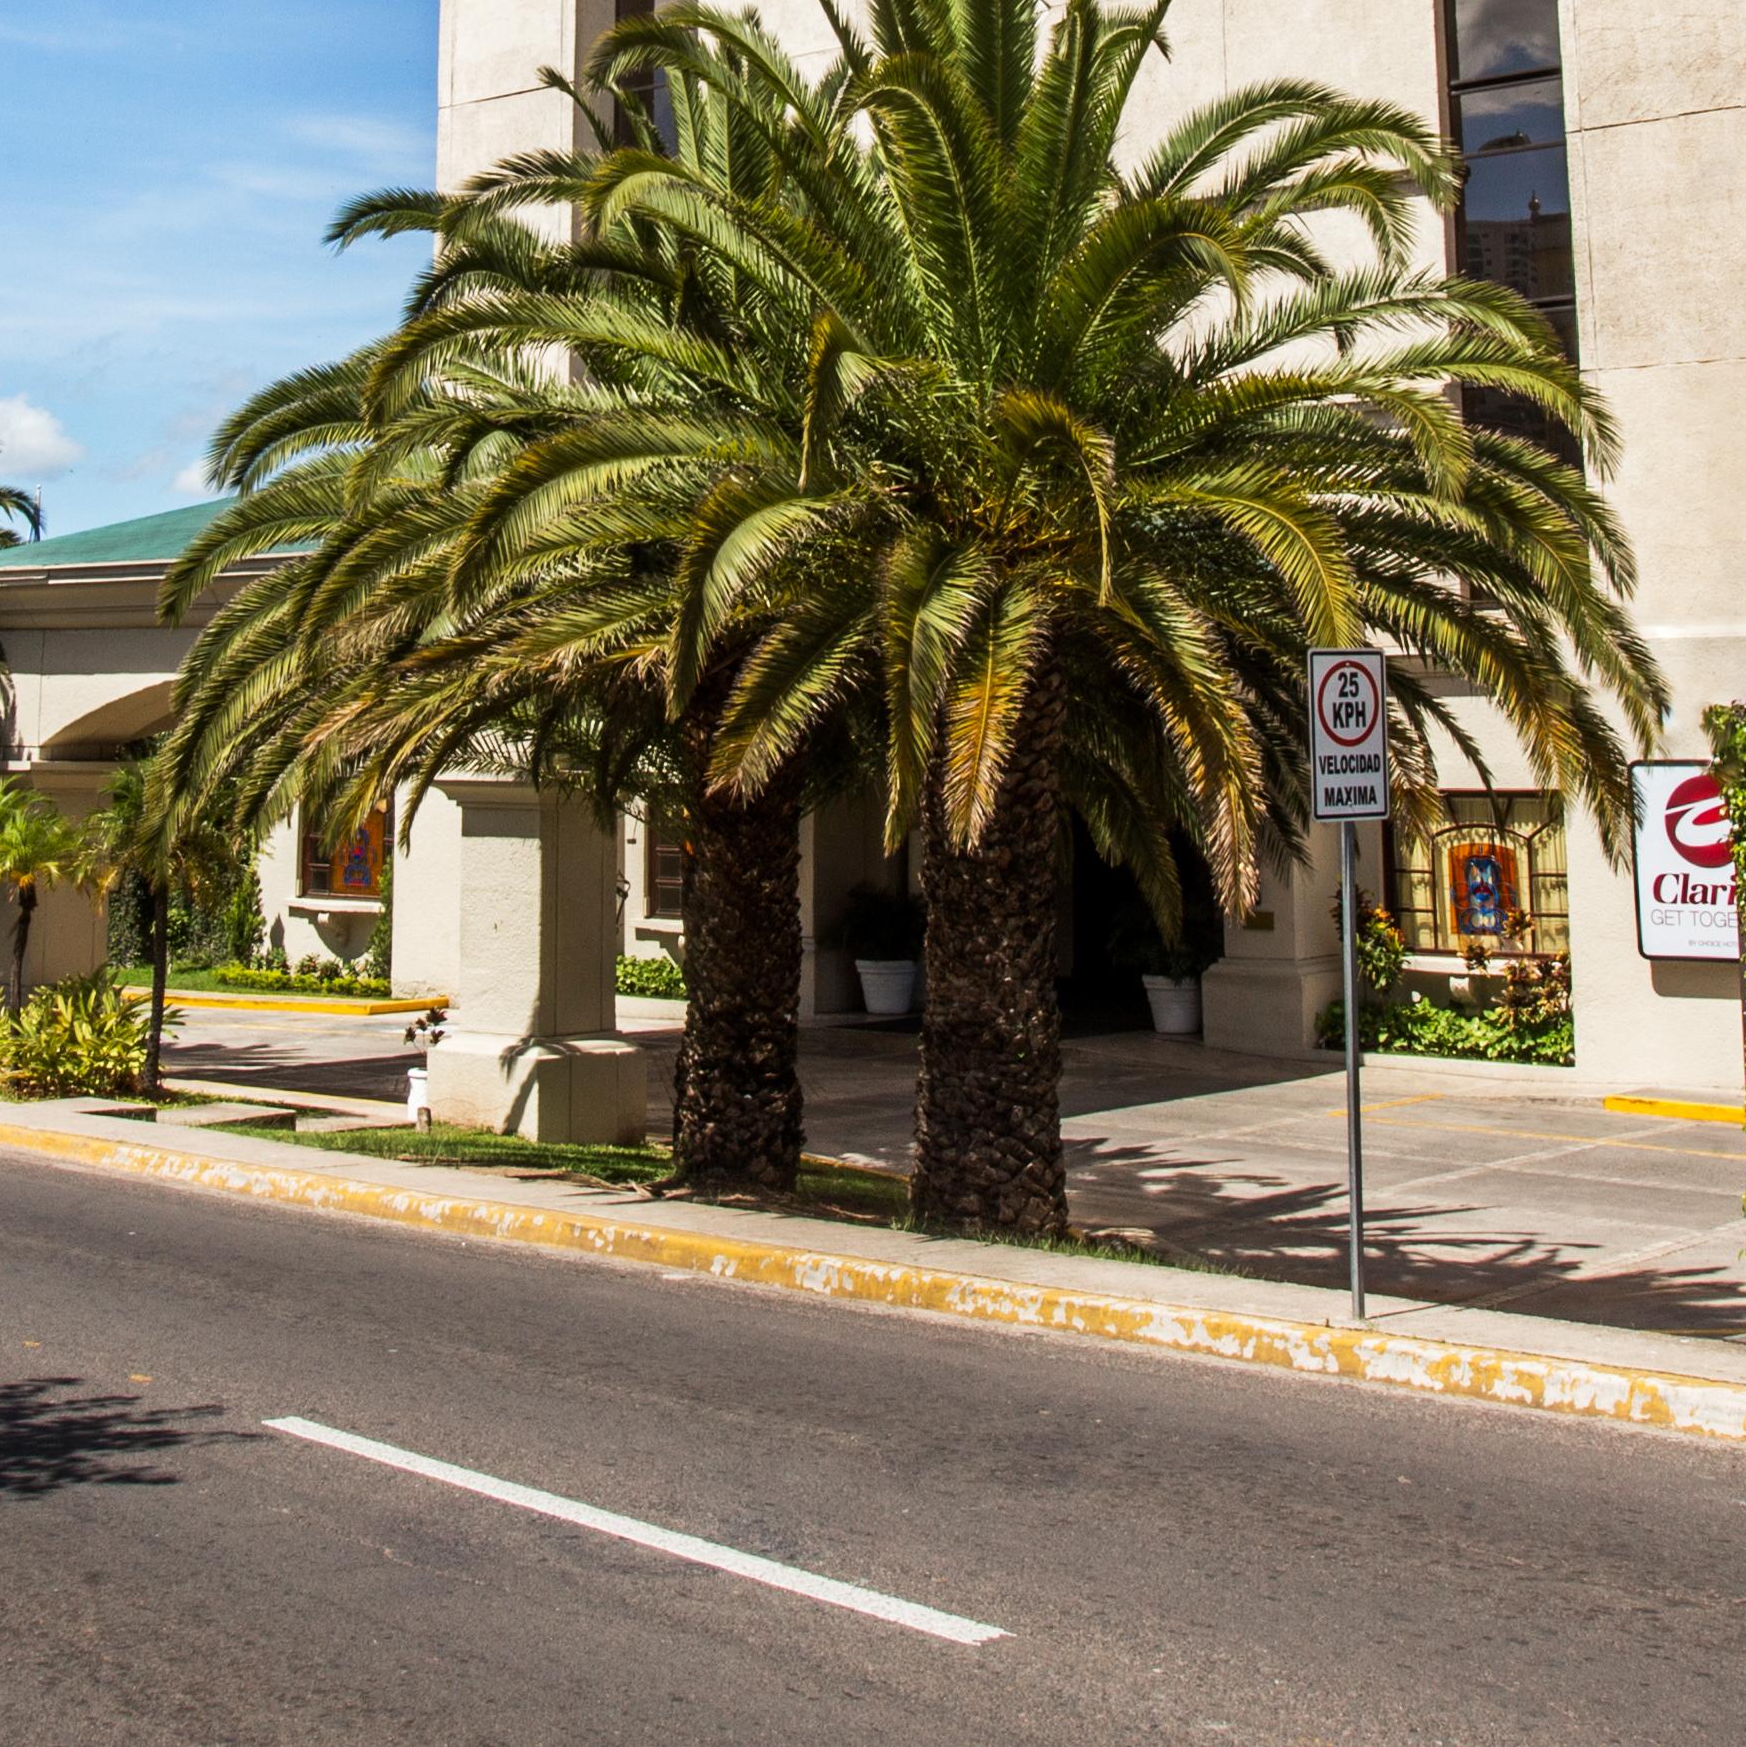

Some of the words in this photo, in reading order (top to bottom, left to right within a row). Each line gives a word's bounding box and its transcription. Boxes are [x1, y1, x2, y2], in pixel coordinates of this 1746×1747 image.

[1338, 672, 1359, 698] 25
[1332, 702, 1366, 728] KPH
[1318, 754, 1381, 775] VELOCIDAD
[1324, 785, 1378, 807] MAXIMA
[1651, 908, 1684, 926] GET
